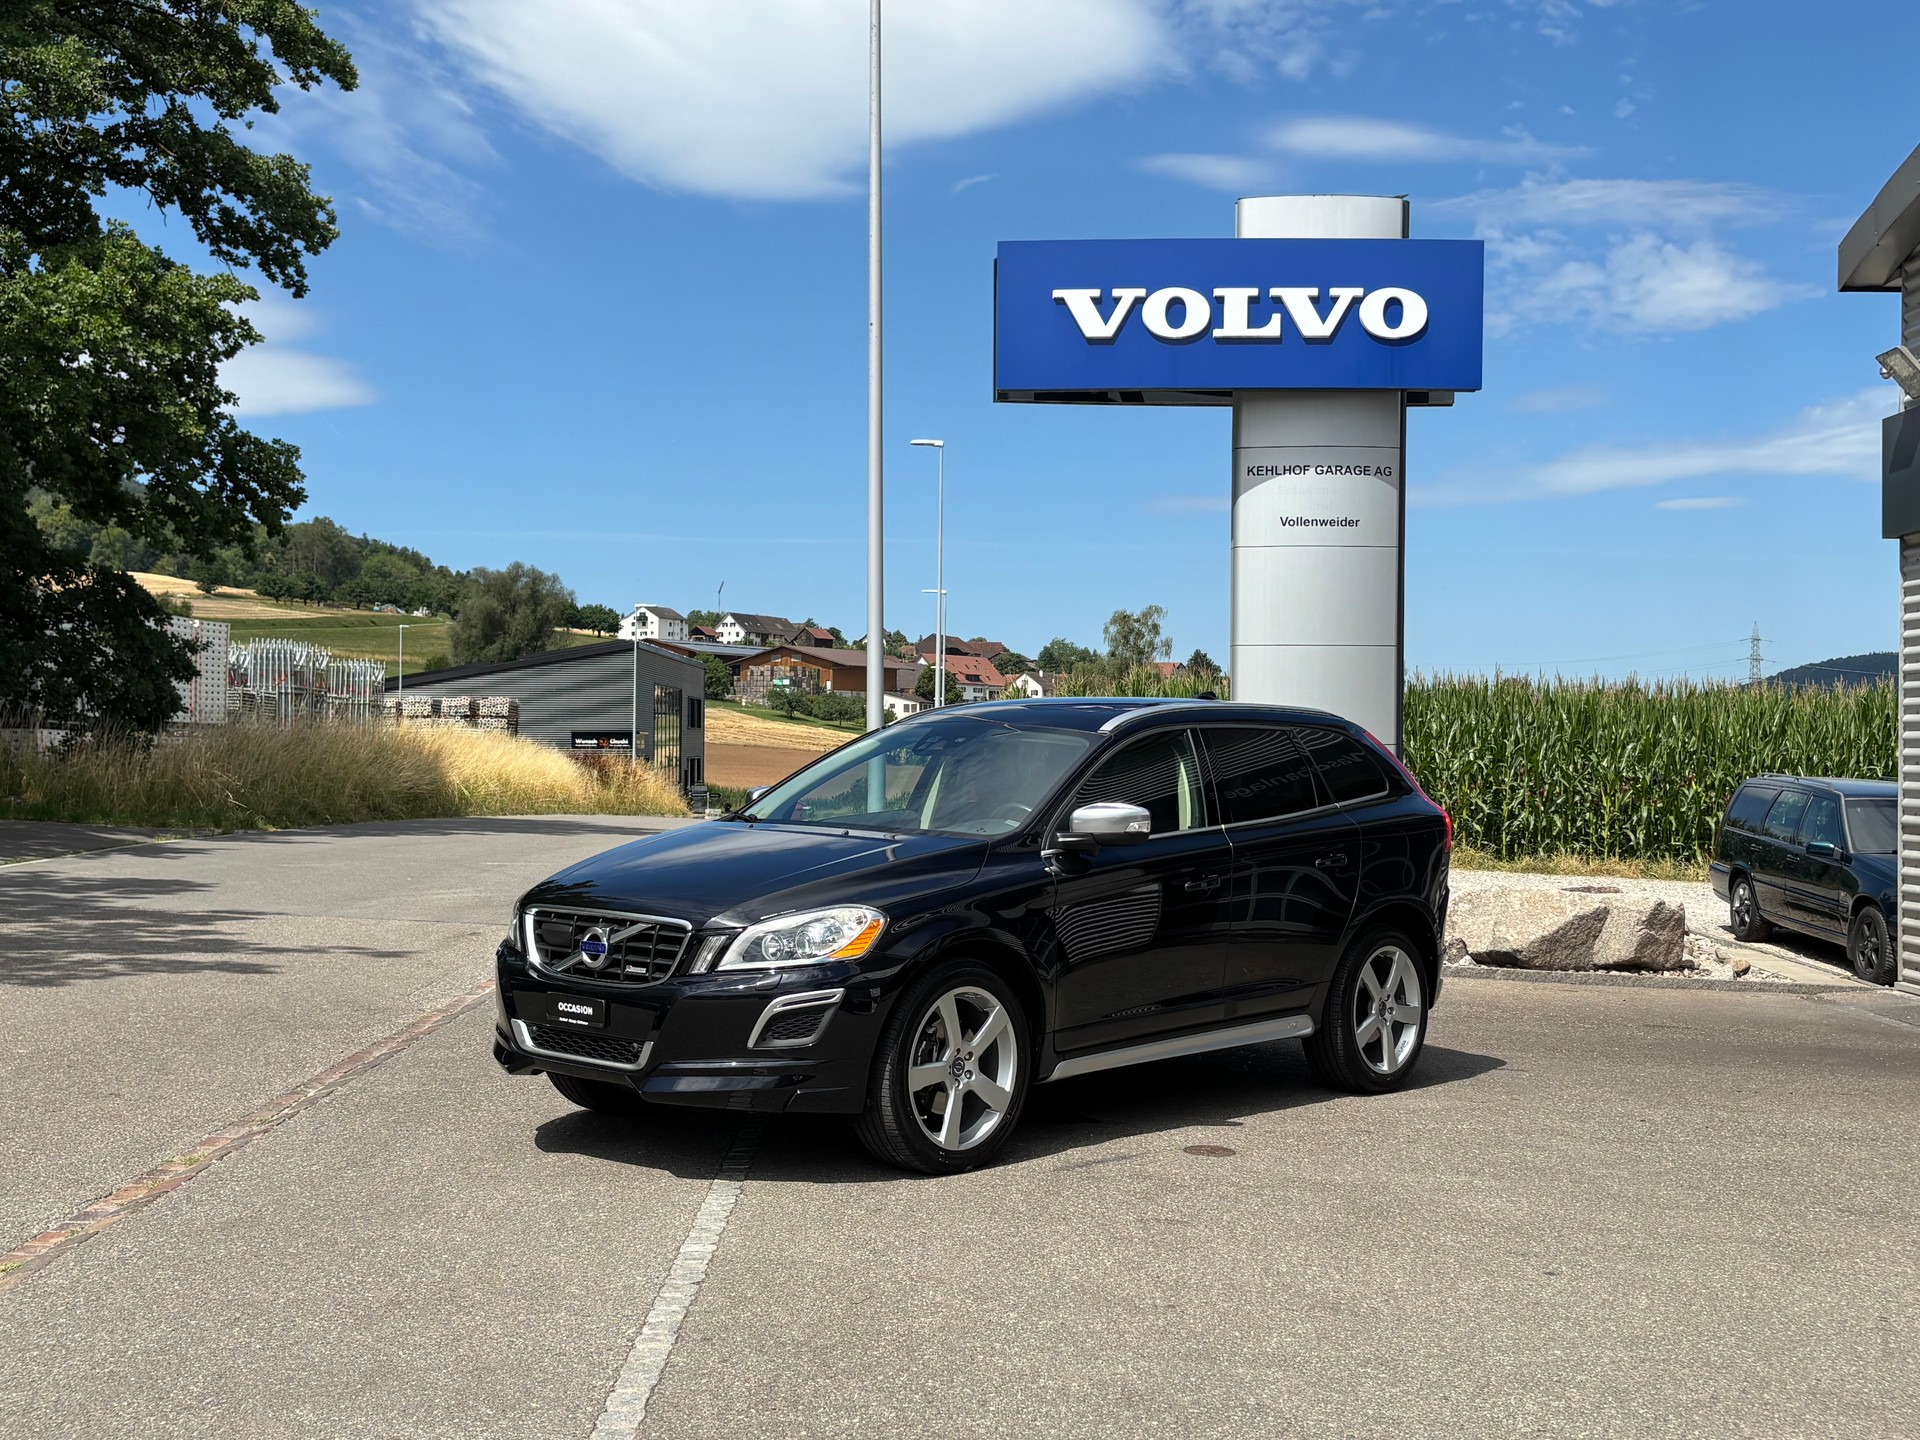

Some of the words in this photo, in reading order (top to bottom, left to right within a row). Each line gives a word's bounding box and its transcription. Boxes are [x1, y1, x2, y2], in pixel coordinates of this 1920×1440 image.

[1052, 287, 1428, 338] VOLVO
[1246, 464, 1311, 477] KEHLHOF
[1314, 464, 1372, 477] GARAGE
[1374, 465, 1393, 477] AG
[1279, 516, 1361, 528] Vollenweider
[557, 1001, 593, 1016] OCCASION
